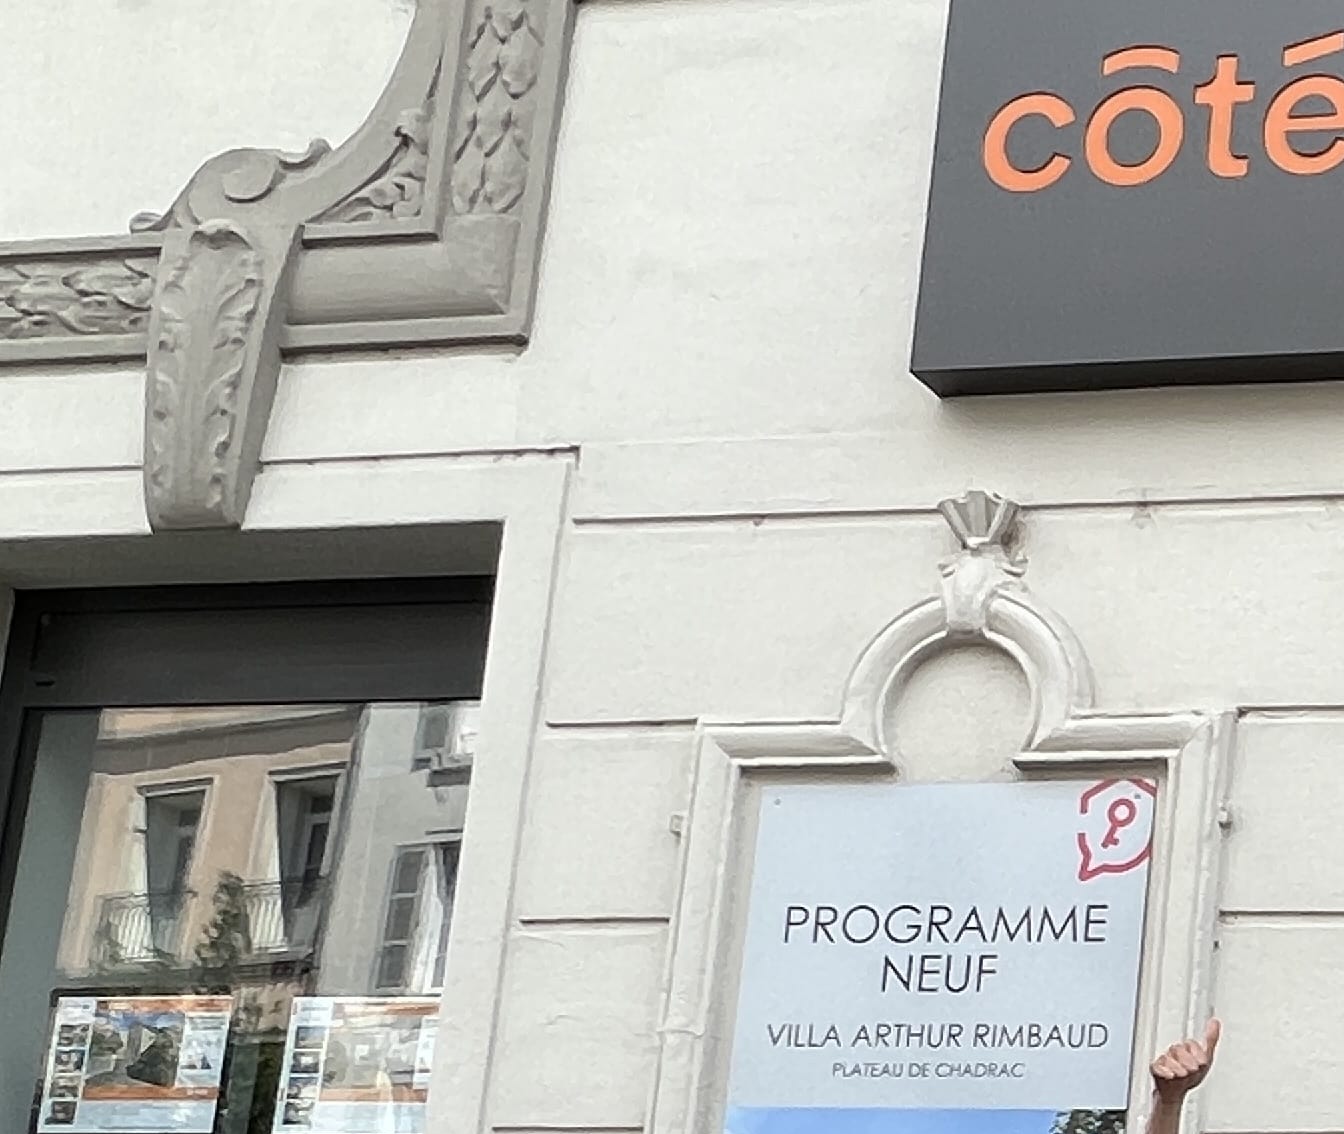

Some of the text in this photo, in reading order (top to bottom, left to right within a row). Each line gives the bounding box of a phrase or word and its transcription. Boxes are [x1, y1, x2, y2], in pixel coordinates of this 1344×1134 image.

[785, 905, 1108, 943] PROGRAMME
[882, 955, 997, 993] NEUF
[768, 1024, 1107, 1048] VILLA ARTHUR RIMBAUD
[833, 1063, 1023, 1077] PLATEAU DE CHADRAC
